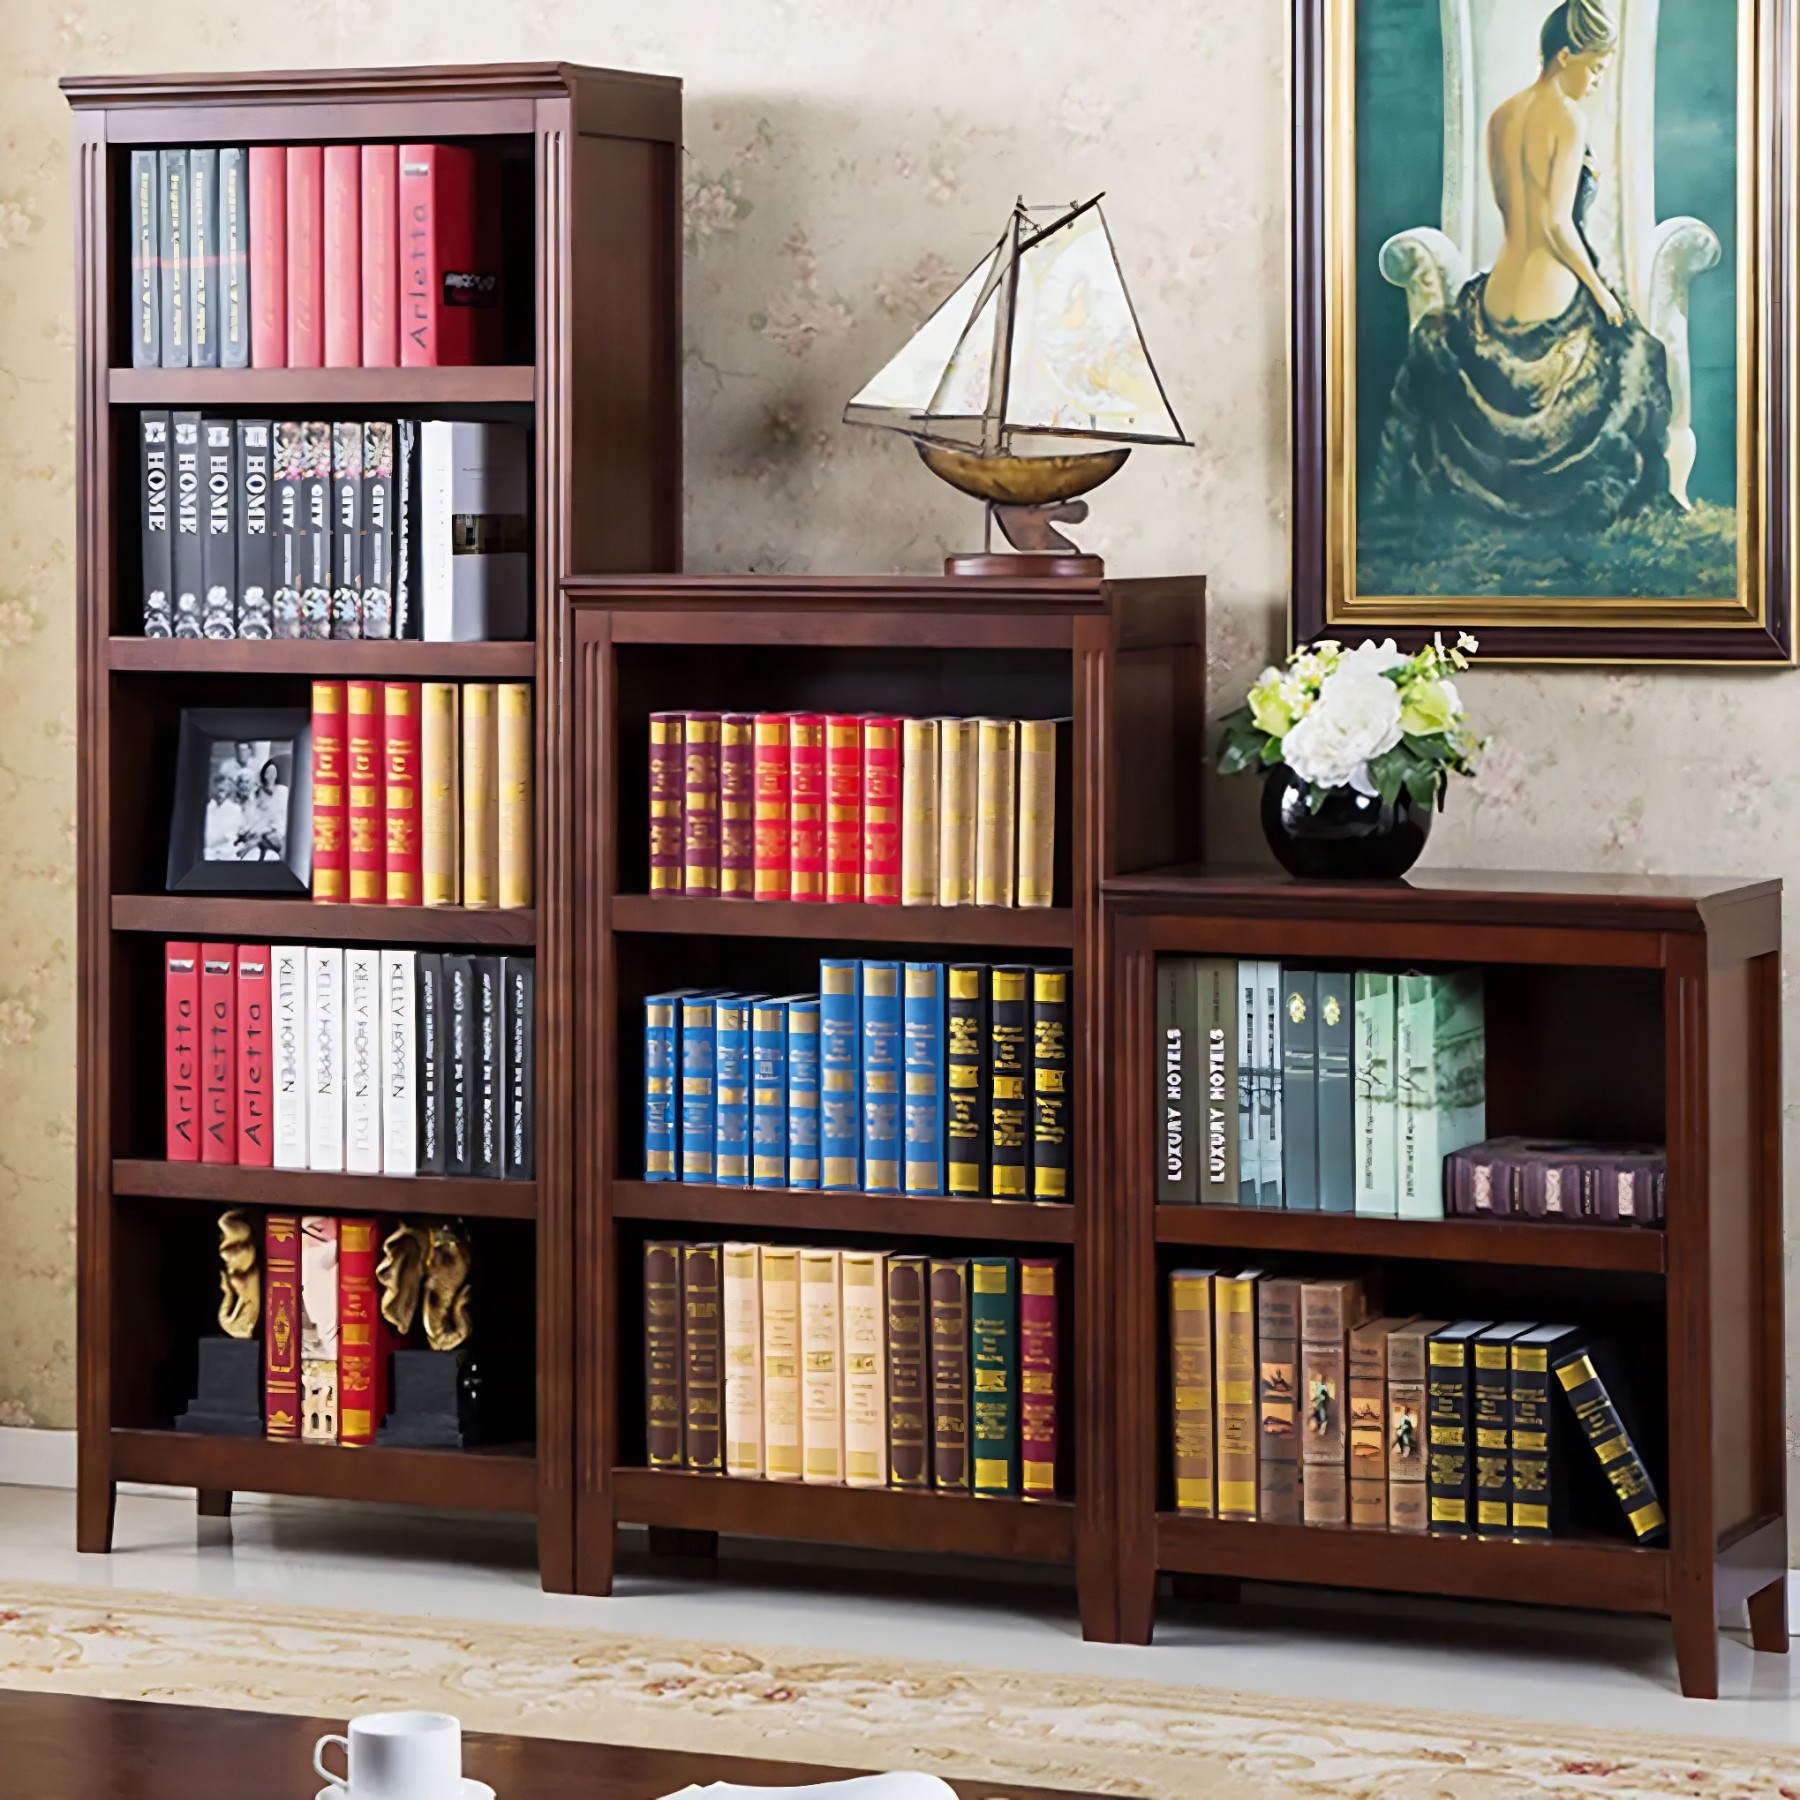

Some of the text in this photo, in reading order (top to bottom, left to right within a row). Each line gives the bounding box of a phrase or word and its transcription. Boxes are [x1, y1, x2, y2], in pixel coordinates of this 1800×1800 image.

[147, 452, 166, 532] HOME
[179, 453, 198, 535] HOME
[208, 455, 229, 535] HOME
[245, 455, 266, 535] HOME
[173, 999, 193, 1143] Arletta
[207, 1001, 227, 1145] Arletta
[244, 1003, 262, 1147] Arletta
[1166, 1027, 1182, 1100] HOTELS
[1209, 1027, 1226, 1101] HOTELS
[1166, 1106, 1183, 1182] LUXURY
[1209, 1107, 1226, 1184] LUXURY
